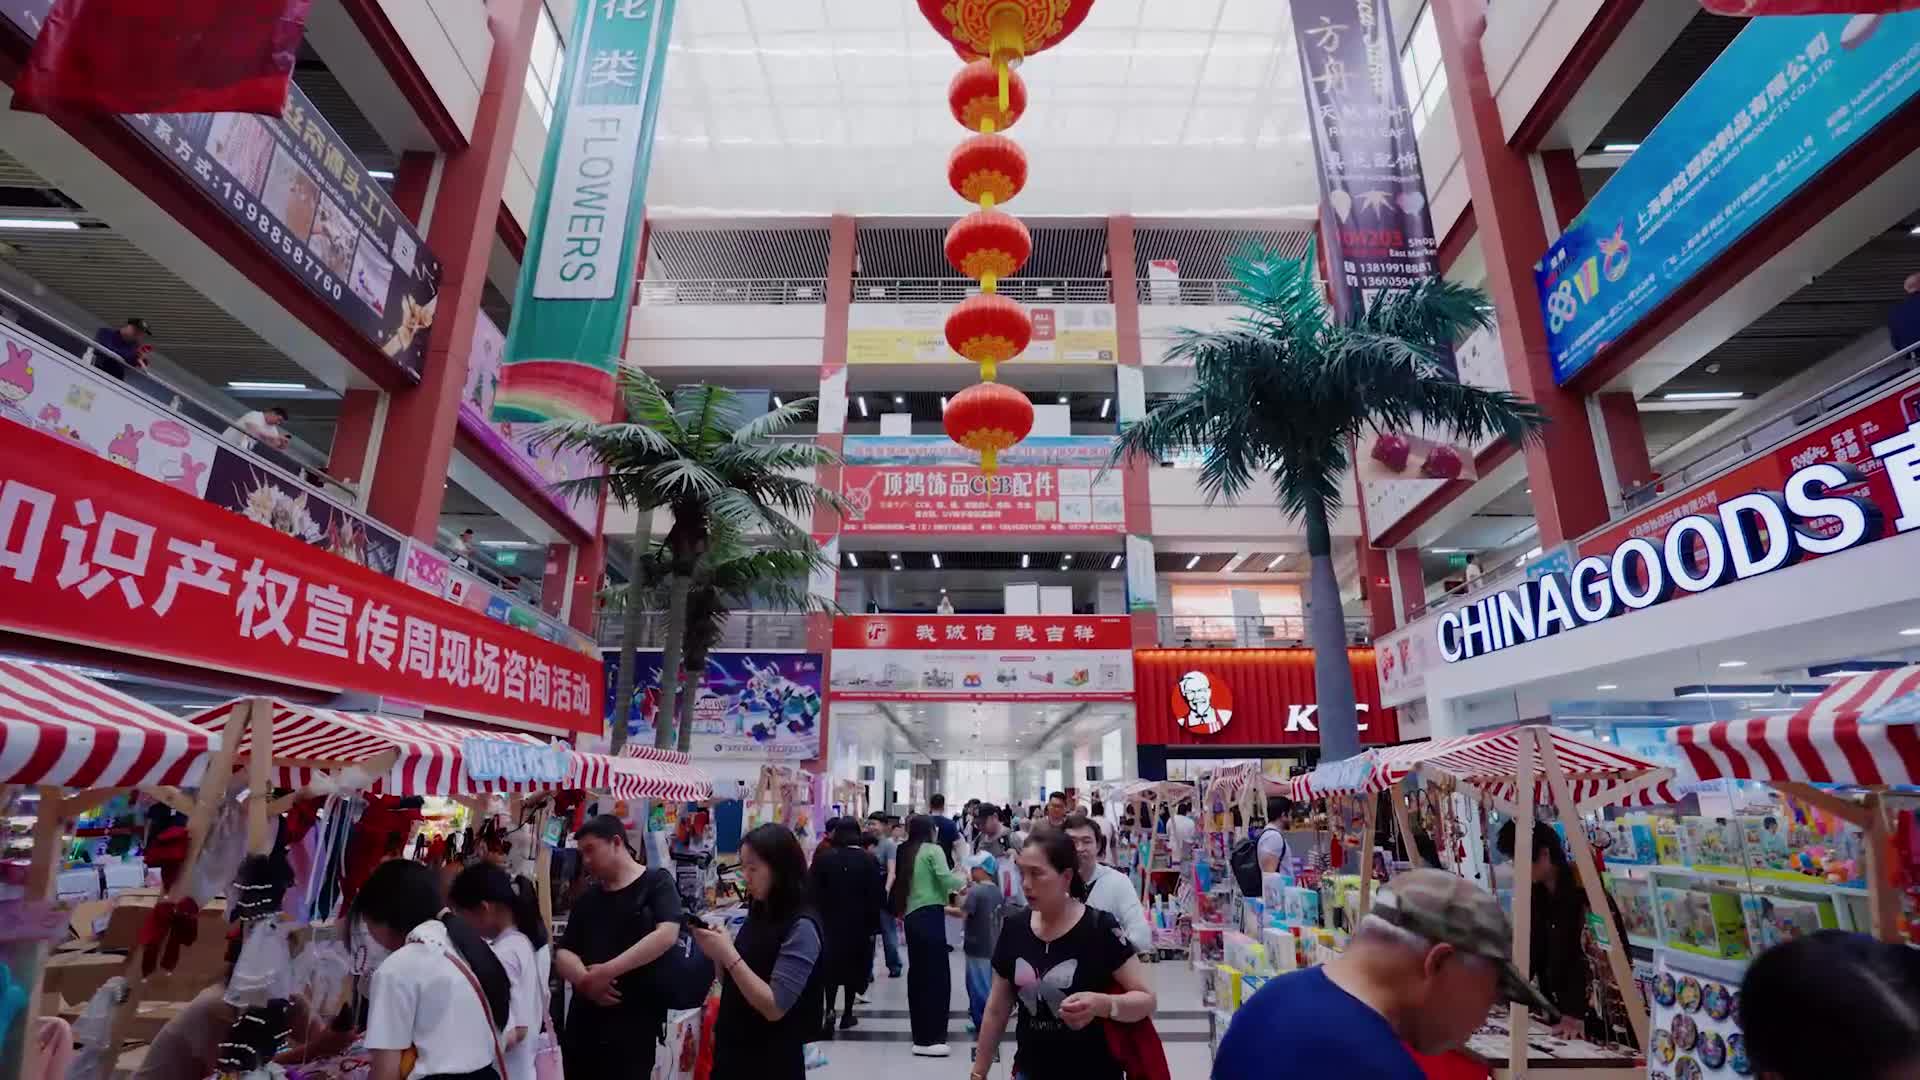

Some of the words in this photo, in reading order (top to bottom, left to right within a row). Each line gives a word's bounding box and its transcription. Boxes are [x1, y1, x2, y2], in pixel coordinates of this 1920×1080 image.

[558, 117, 622, 283] FLOWERS
[916, 624, 997, 643] 我诚信
[1015, 624, 1096, 643] 我吉祥
[1437, 462, 1868, 664] CHINAGOODS
